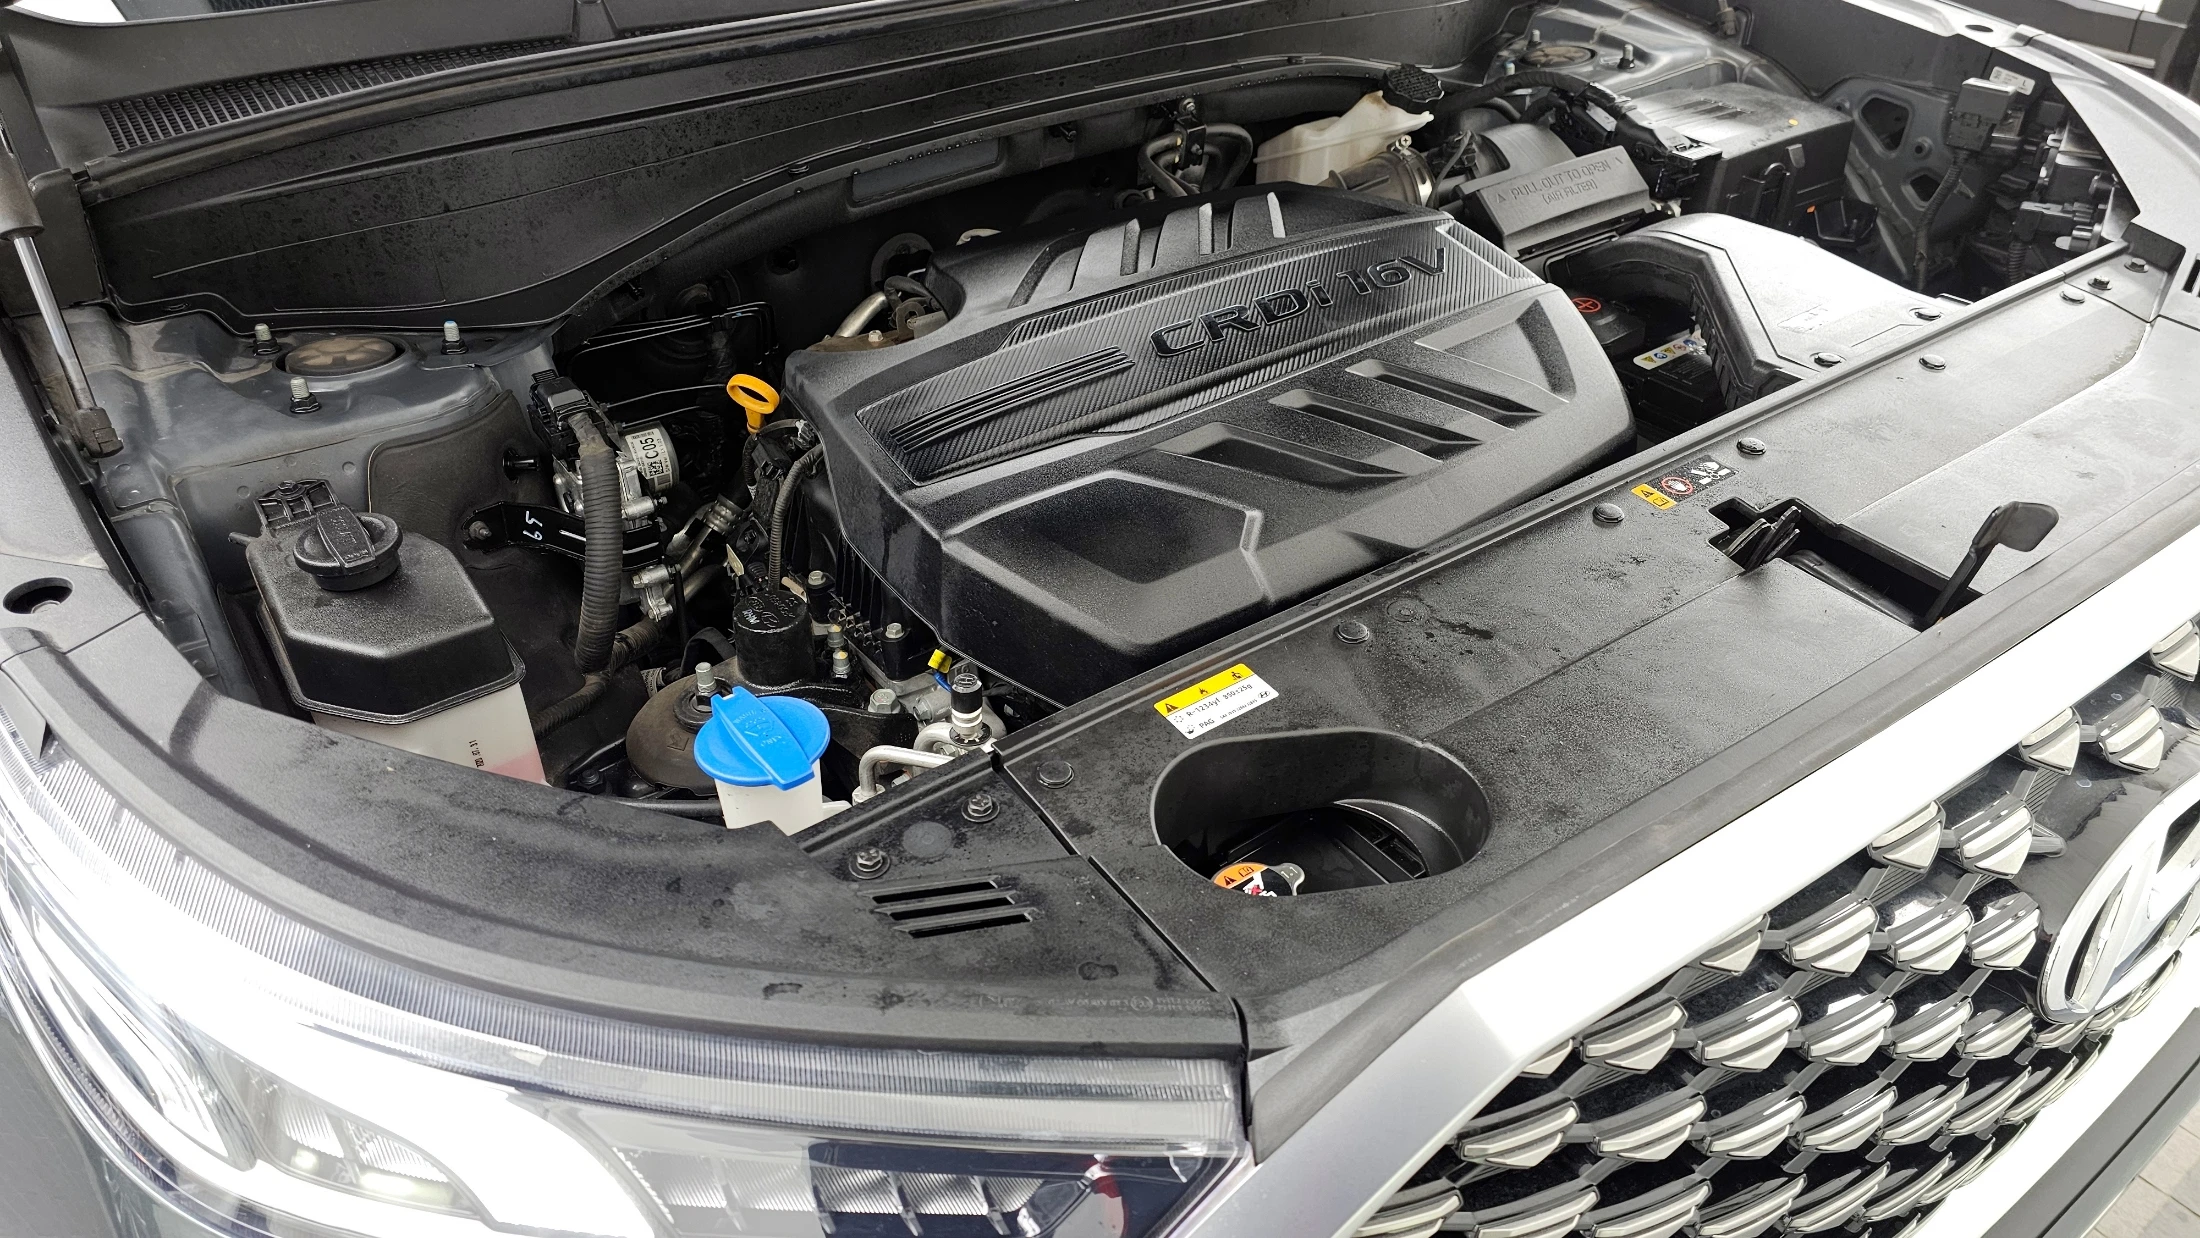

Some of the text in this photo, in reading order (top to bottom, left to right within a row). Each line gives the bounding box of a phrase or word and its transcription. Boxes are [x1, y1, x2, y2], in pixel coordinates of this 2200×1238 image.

[1510, 159, 1612, 200] PULL OUT TO OPEN
[1542, 178, 1599, 205] (AIR FILTER)
[1149, 247, 1447, 357] CRDi 16V
[640, 437, 659, 459] C05
[1199, 718, 1215, 728] PAG
[1281, 866, 1298, 879] 1.1
